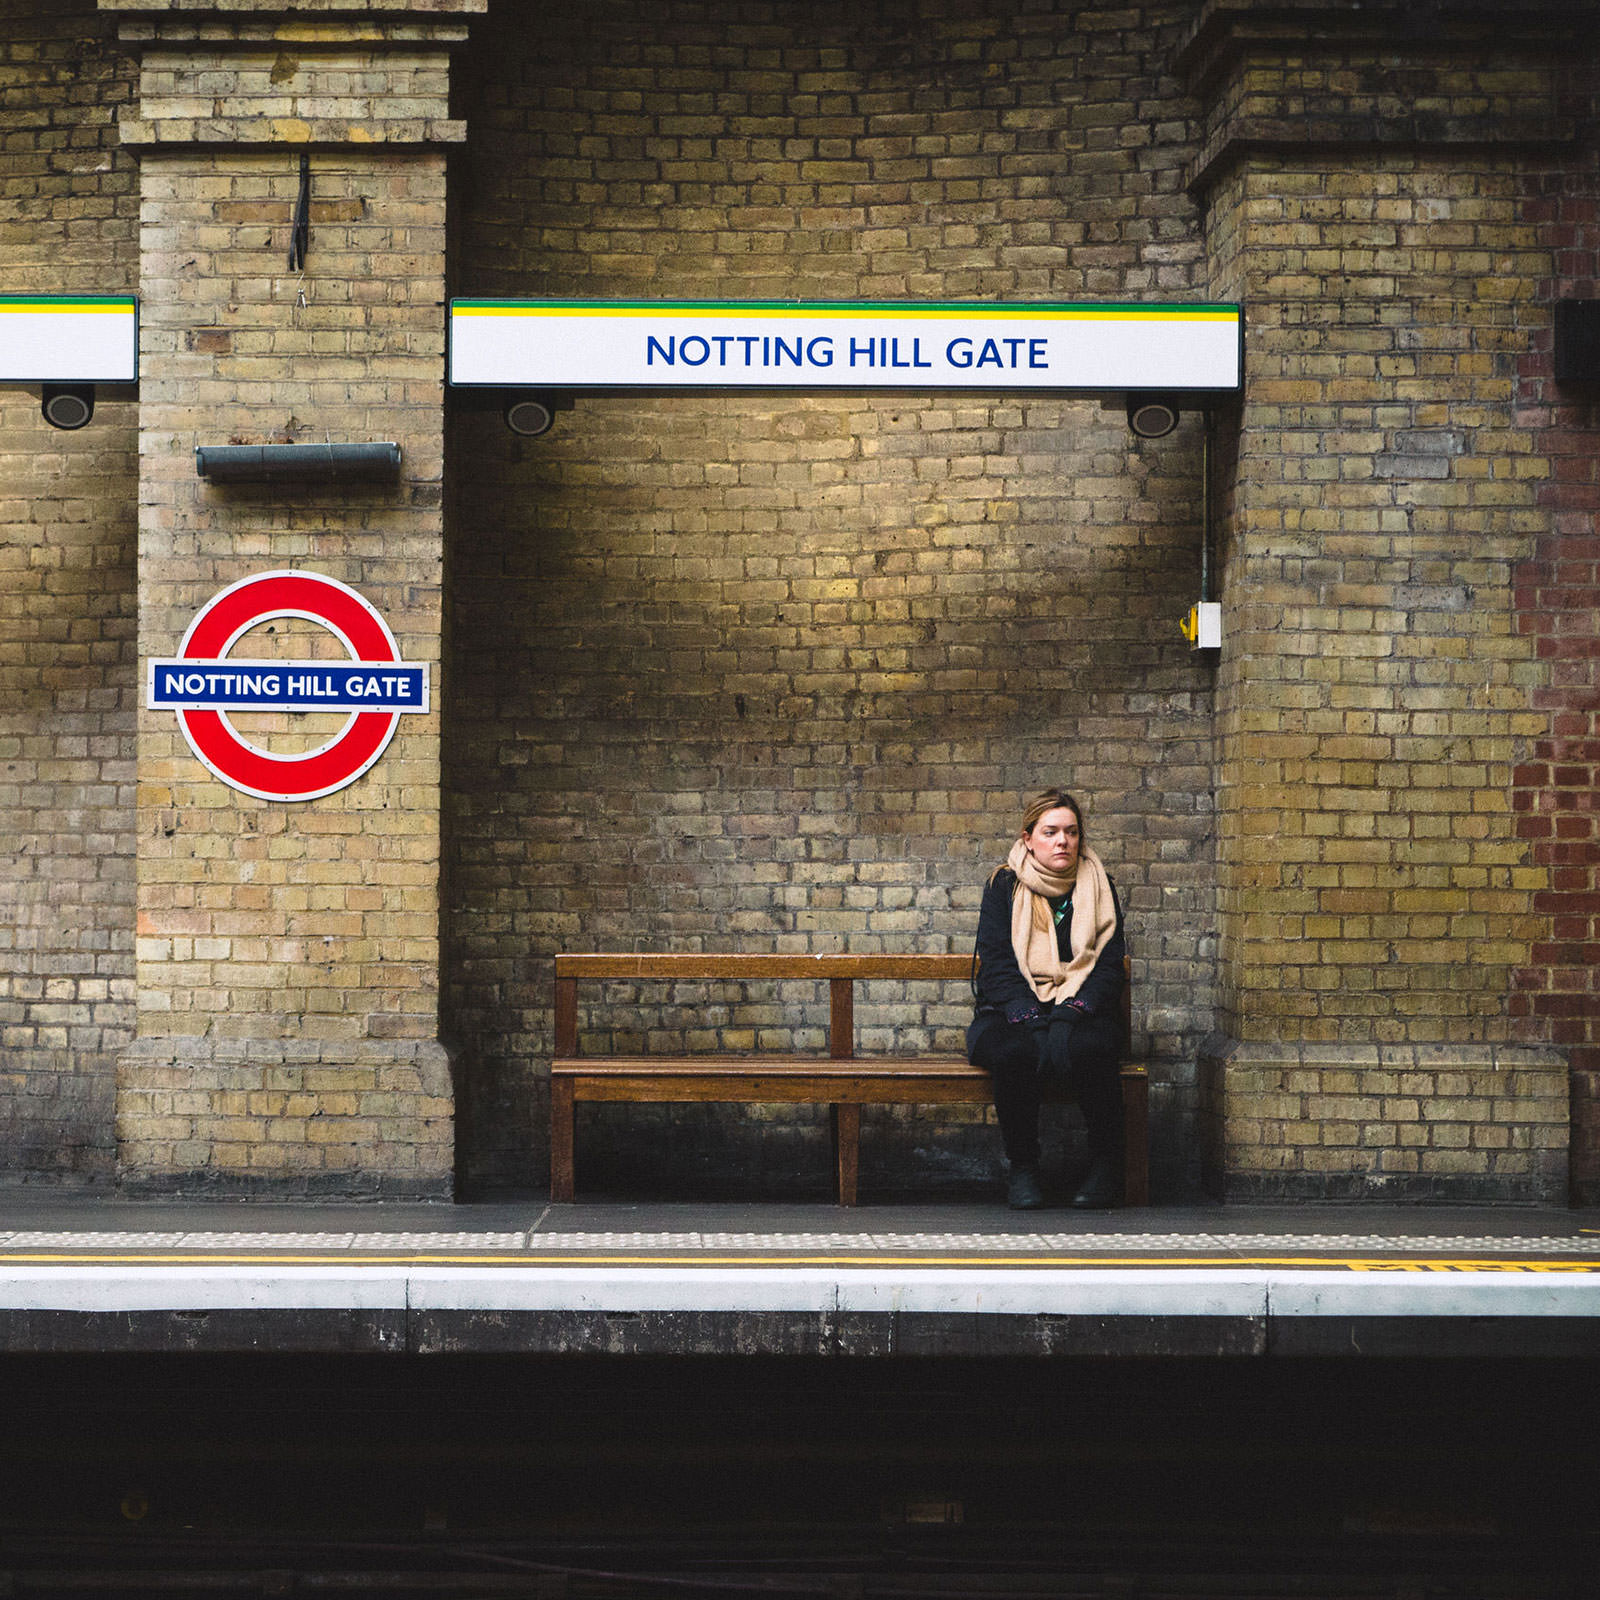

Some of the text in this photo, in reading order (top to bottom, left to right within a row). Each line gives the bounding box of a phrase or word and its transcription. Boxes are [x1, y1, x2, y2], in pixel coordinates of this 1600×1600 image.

[647, 335, 1049, 369] NOTTING HILL GATE
[165, 673, 411, 698] NOTTING HILL GATE
